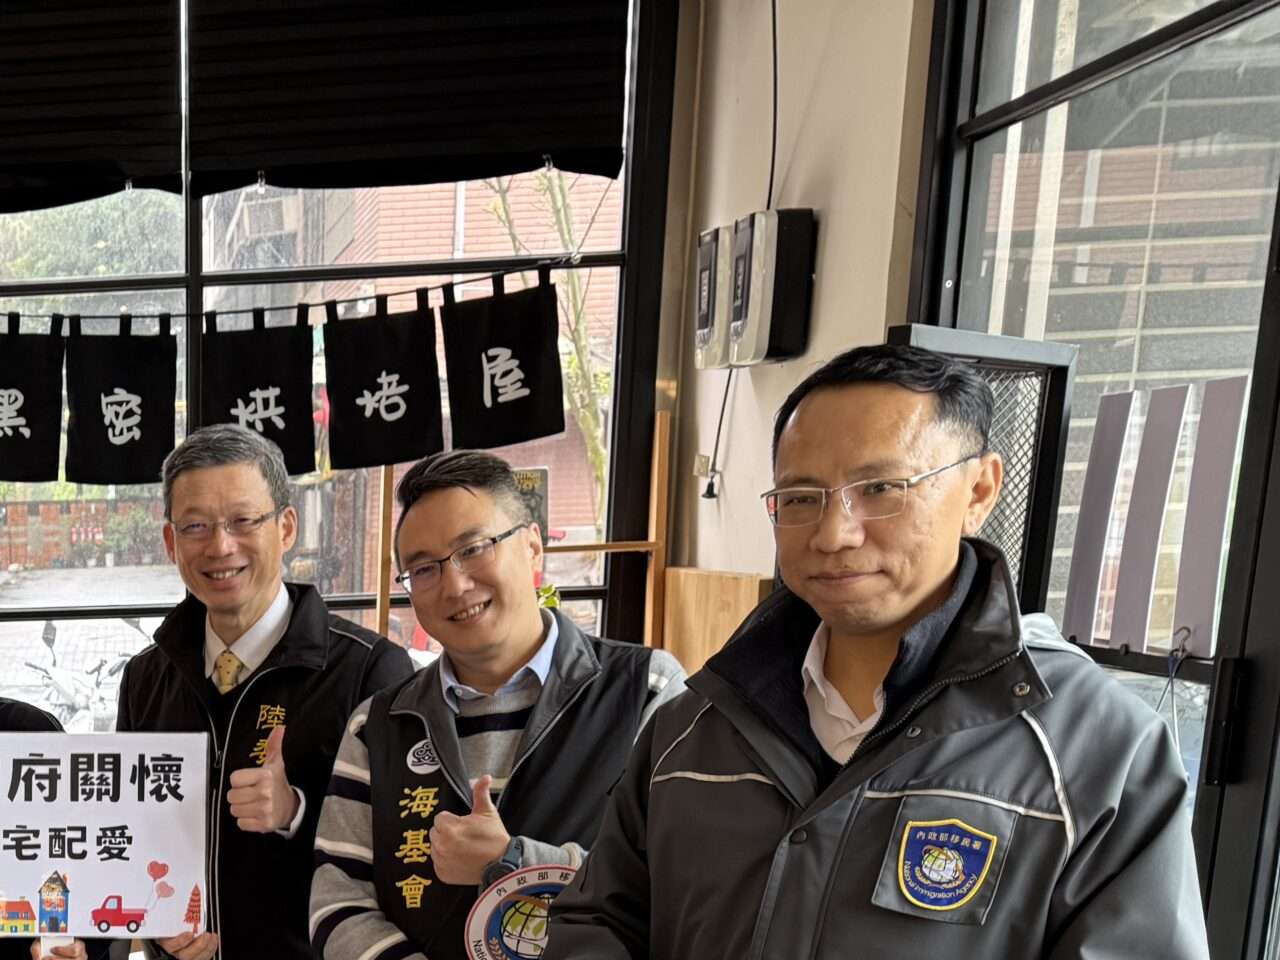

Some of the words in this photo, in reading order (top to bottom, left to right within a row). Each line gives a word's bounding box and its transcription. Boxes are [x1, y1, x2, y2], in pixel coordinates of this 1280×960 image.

[2, 824, 134, 862] 宅配愛
[395, 785, 439, 909] 海基會
